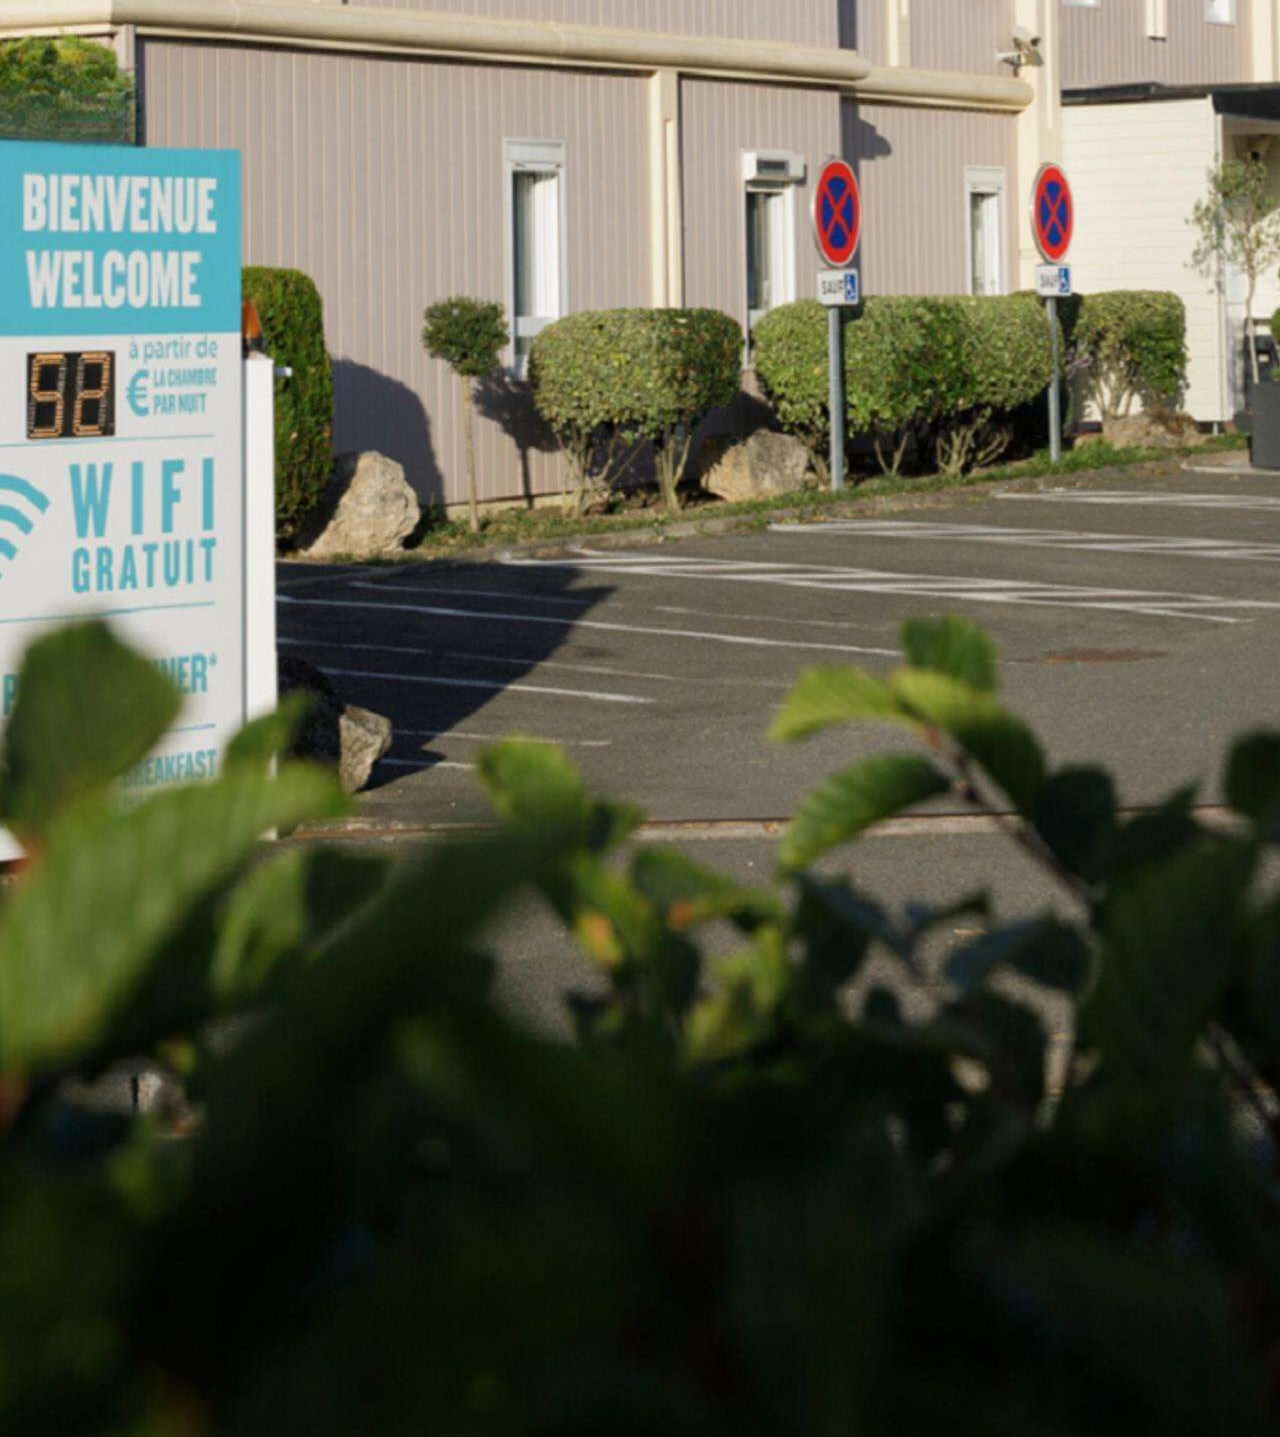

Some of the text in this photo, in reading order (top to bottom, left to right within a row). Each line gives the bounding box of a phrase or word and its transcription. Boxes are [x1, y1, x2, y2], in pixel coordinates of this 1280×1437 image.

[22, 173, 218, 234] BIENVENUE
[26, 250, 202, 309] WELCOME
[129, 335, 218, 364] à partir de
[153, 366, 218, 388] LA CHAMBRE
[29, 351, 111, 439] 52
[125, 369, 150, 417] €
[153, 392, 208, 415] PAR NUIT
[69, 457, 215, 539] WIFI
[72, 537, 217, 593] GRATUIT
